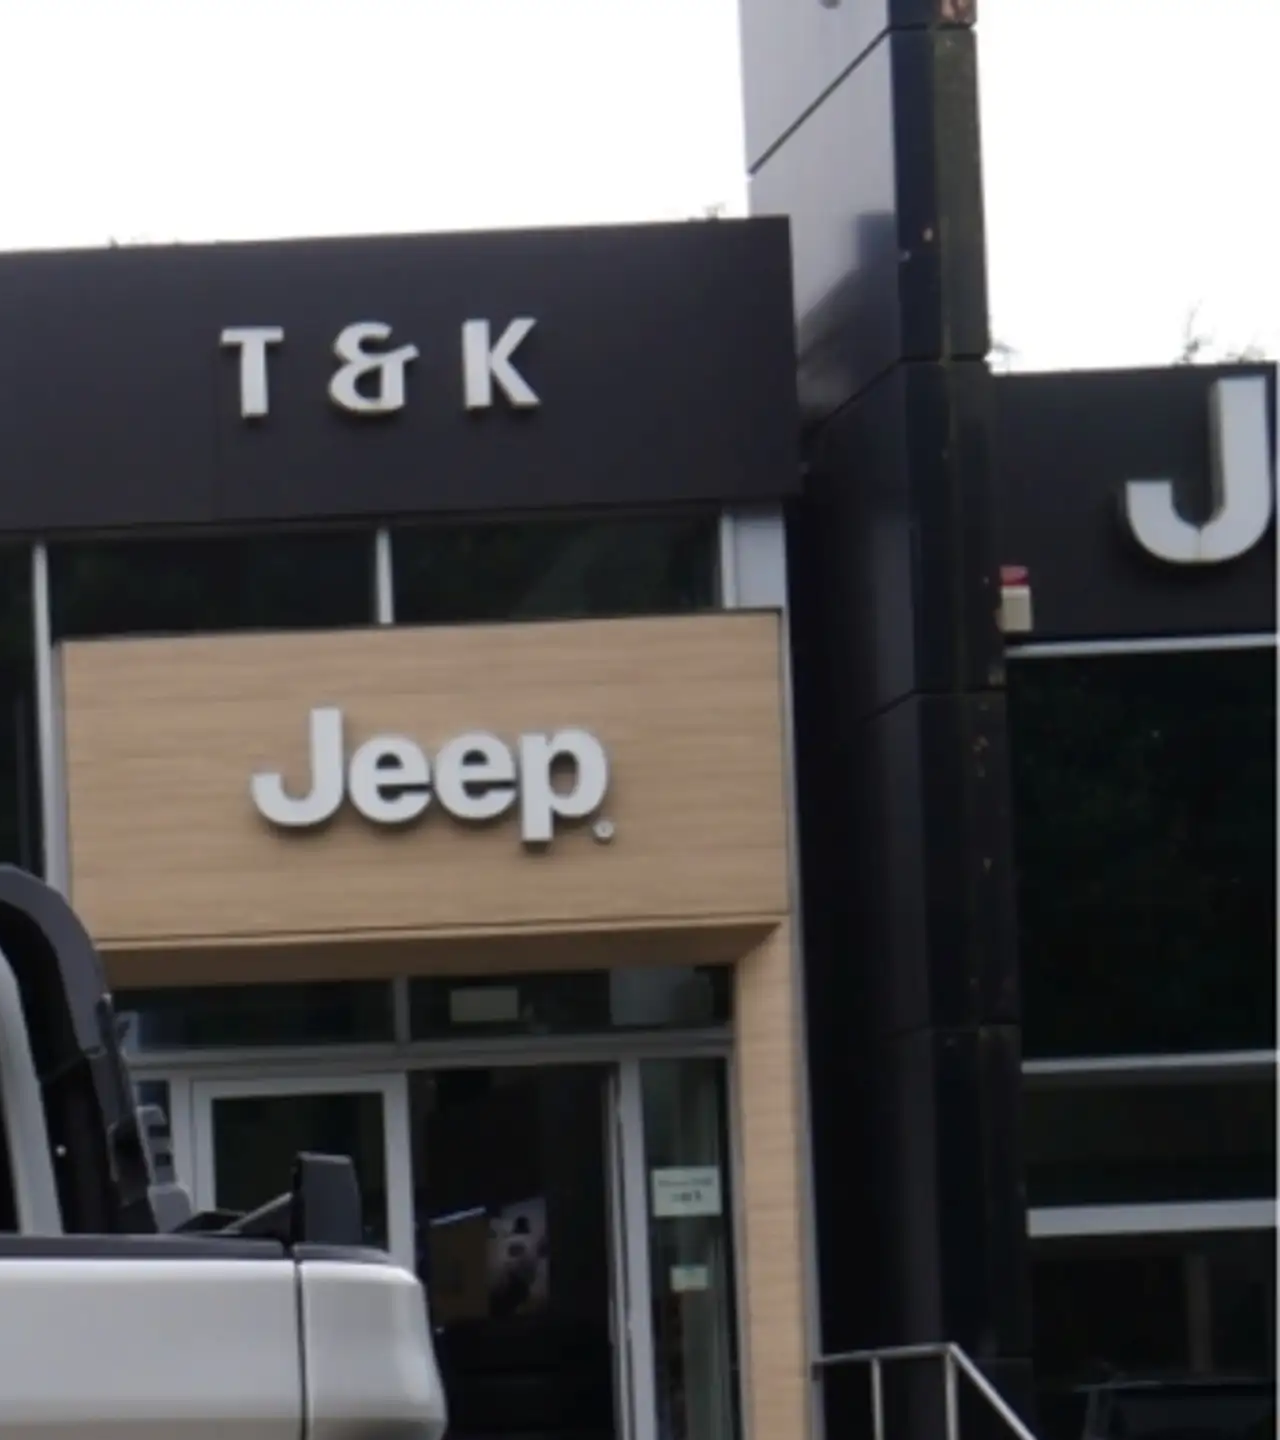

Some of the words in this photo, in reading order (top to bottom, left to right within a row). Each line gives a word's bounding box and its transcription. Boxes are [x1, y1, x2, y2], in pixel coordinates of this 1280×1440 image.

[220, 325, 285, 418] T
[328, 320, 420, 412] &
[461, 316, 542, 410] K
[251, 706, 609, 843] Jeep
